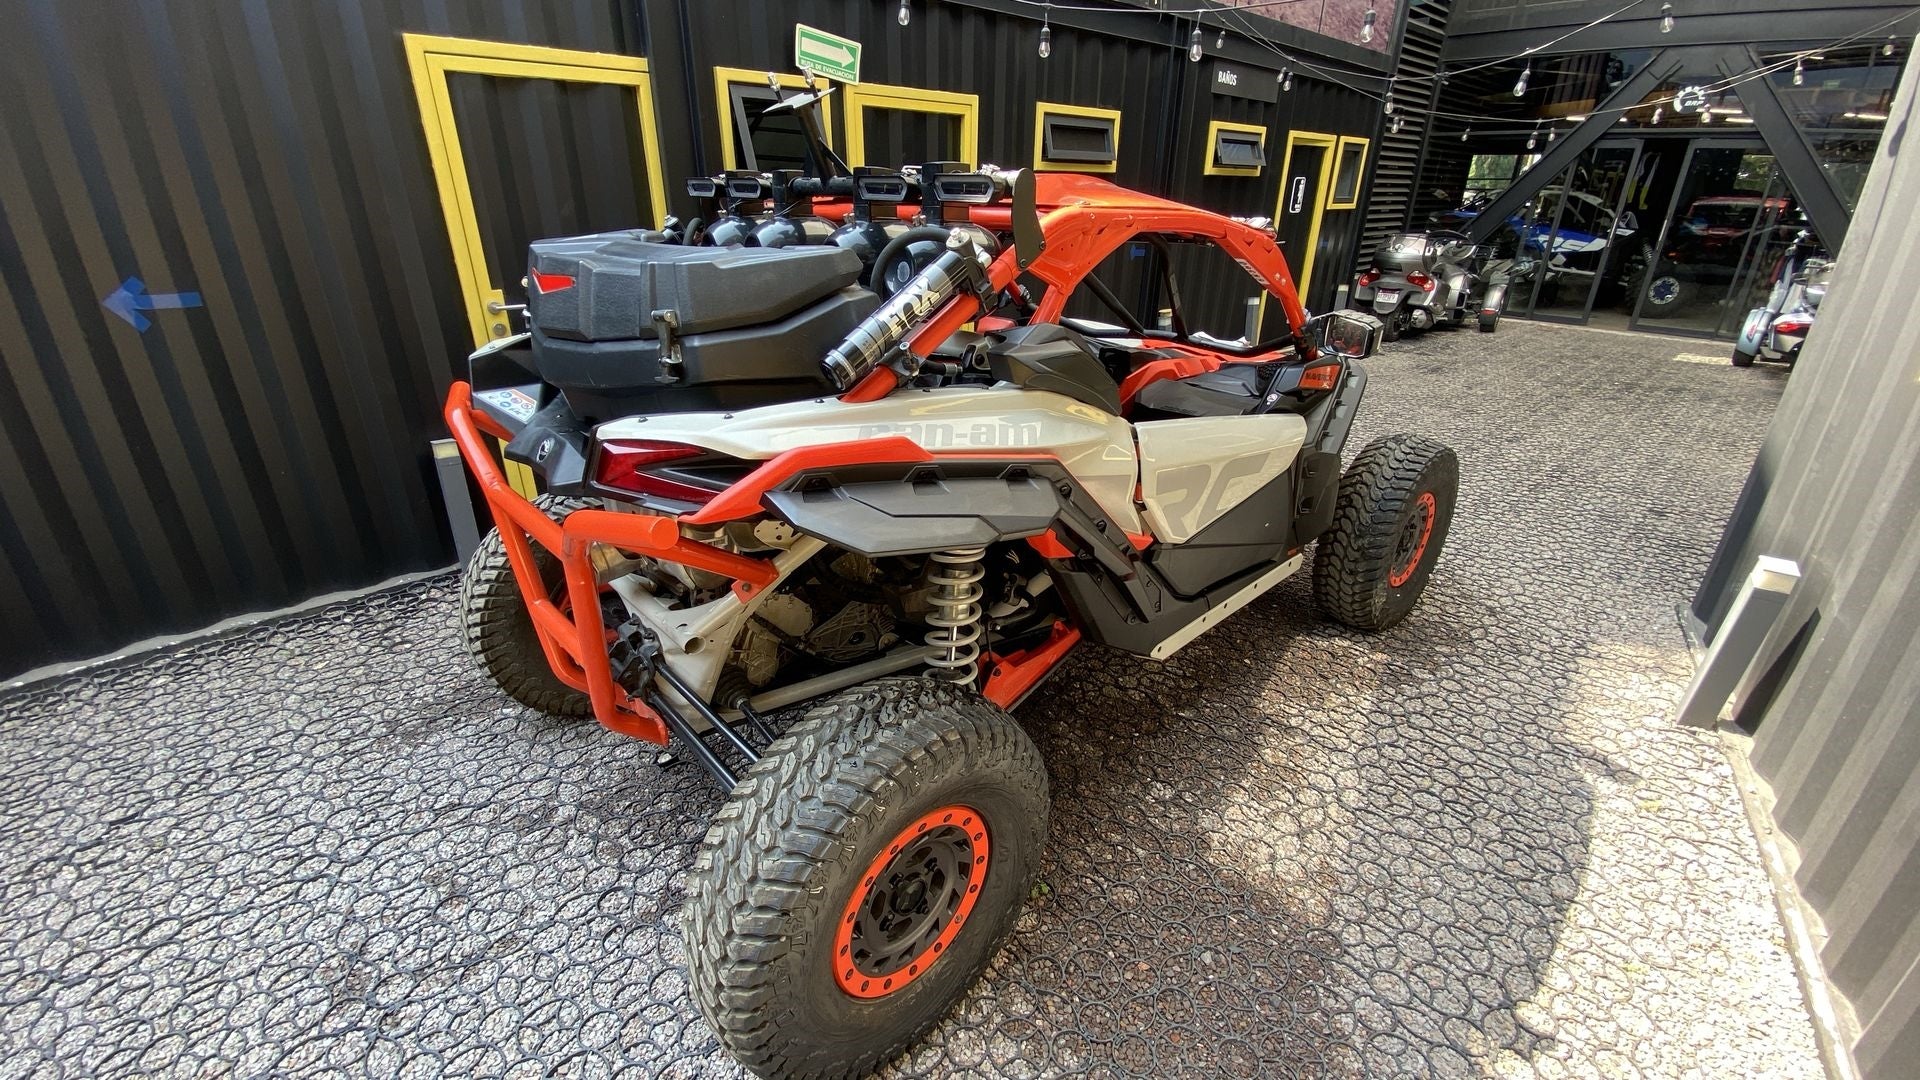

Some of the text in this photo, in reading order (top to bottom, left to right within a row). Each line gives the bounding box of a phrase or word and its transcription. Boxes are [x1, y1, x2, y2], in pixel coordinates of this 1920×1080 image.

[815, 63, 822, 71] DE
[1218, 70, 1238, 86] BAÑOS
[877, 276, 941, 338] FOX
